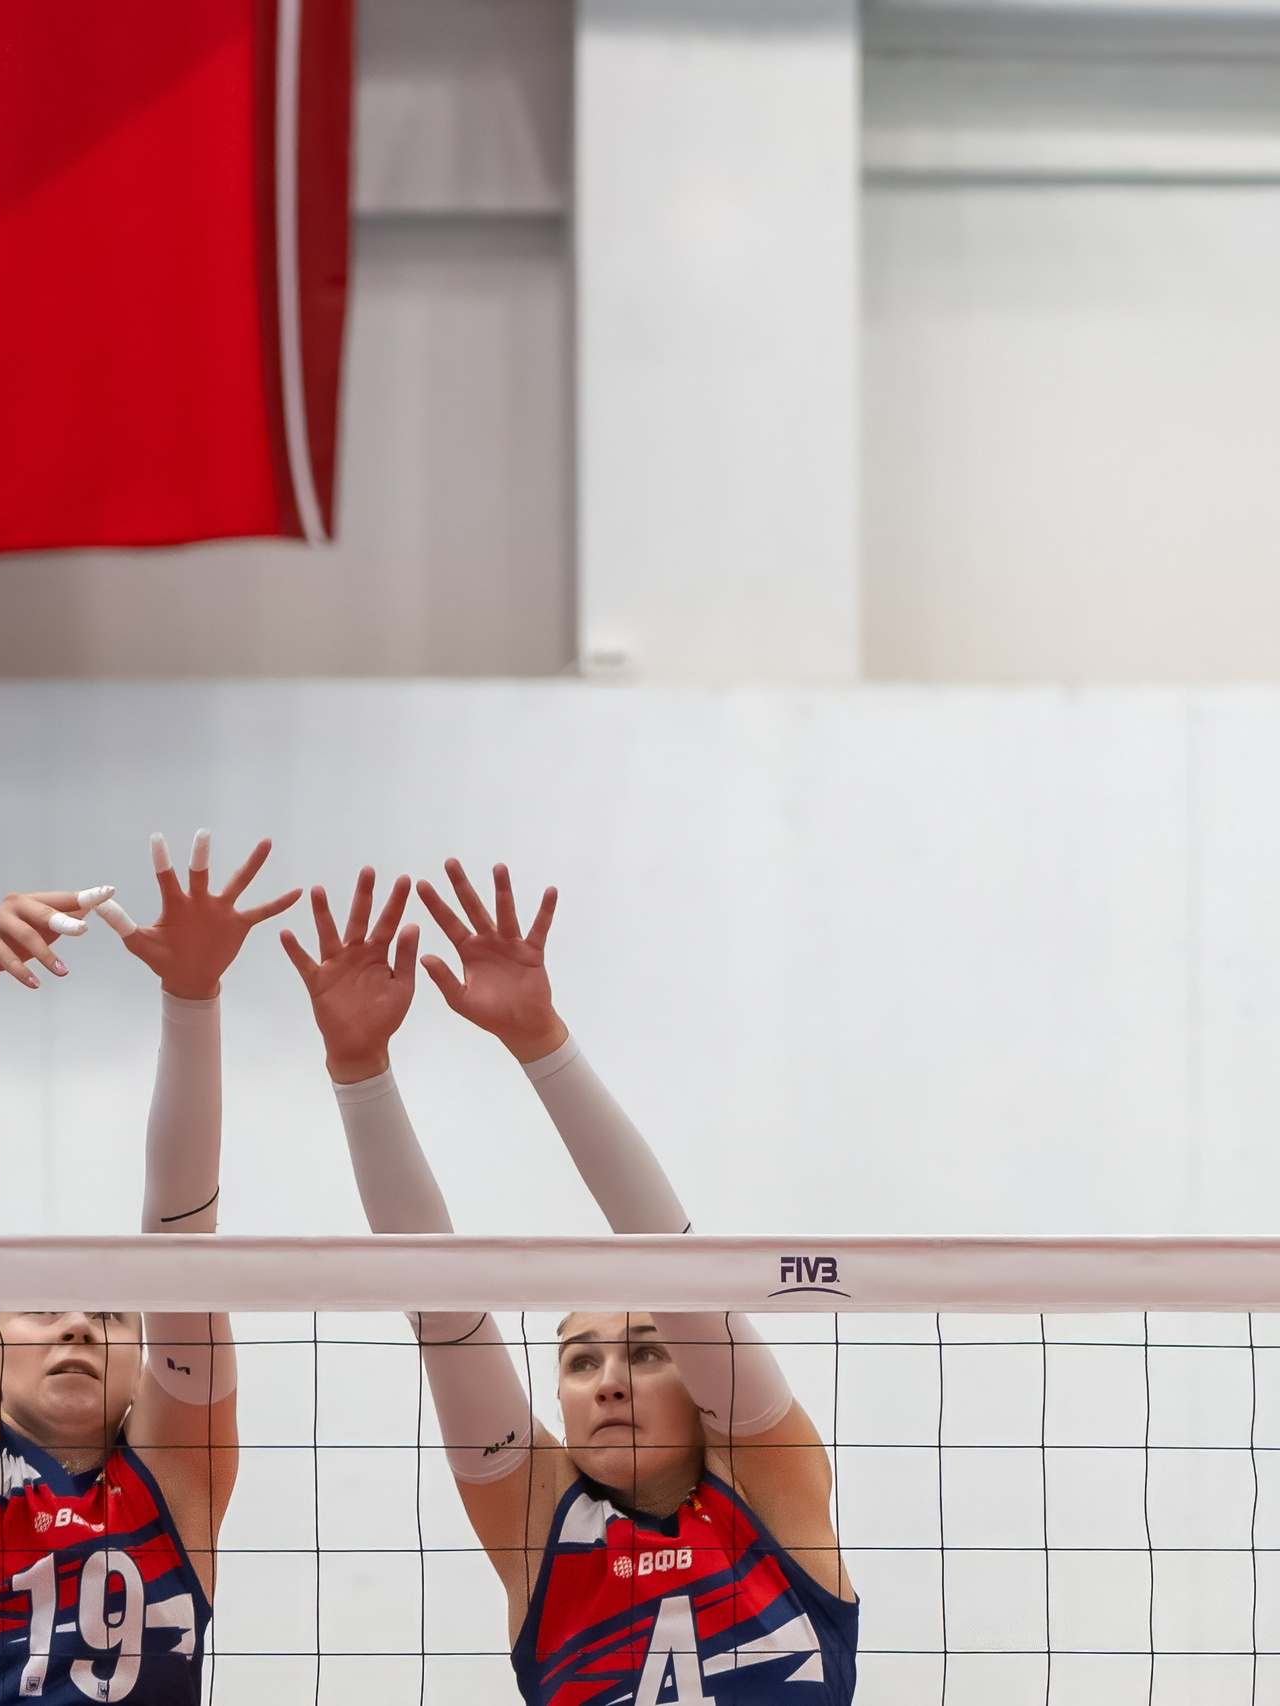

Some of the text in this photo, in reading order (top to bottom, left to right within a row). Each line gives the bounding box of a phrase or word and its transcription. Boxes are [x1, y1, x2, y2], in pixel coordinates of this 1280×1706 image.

[780, 1256, 838, 1283] FIVB
[12, 1548, 144, 1703] 19
[634, 1595, 716, 1706] 4
